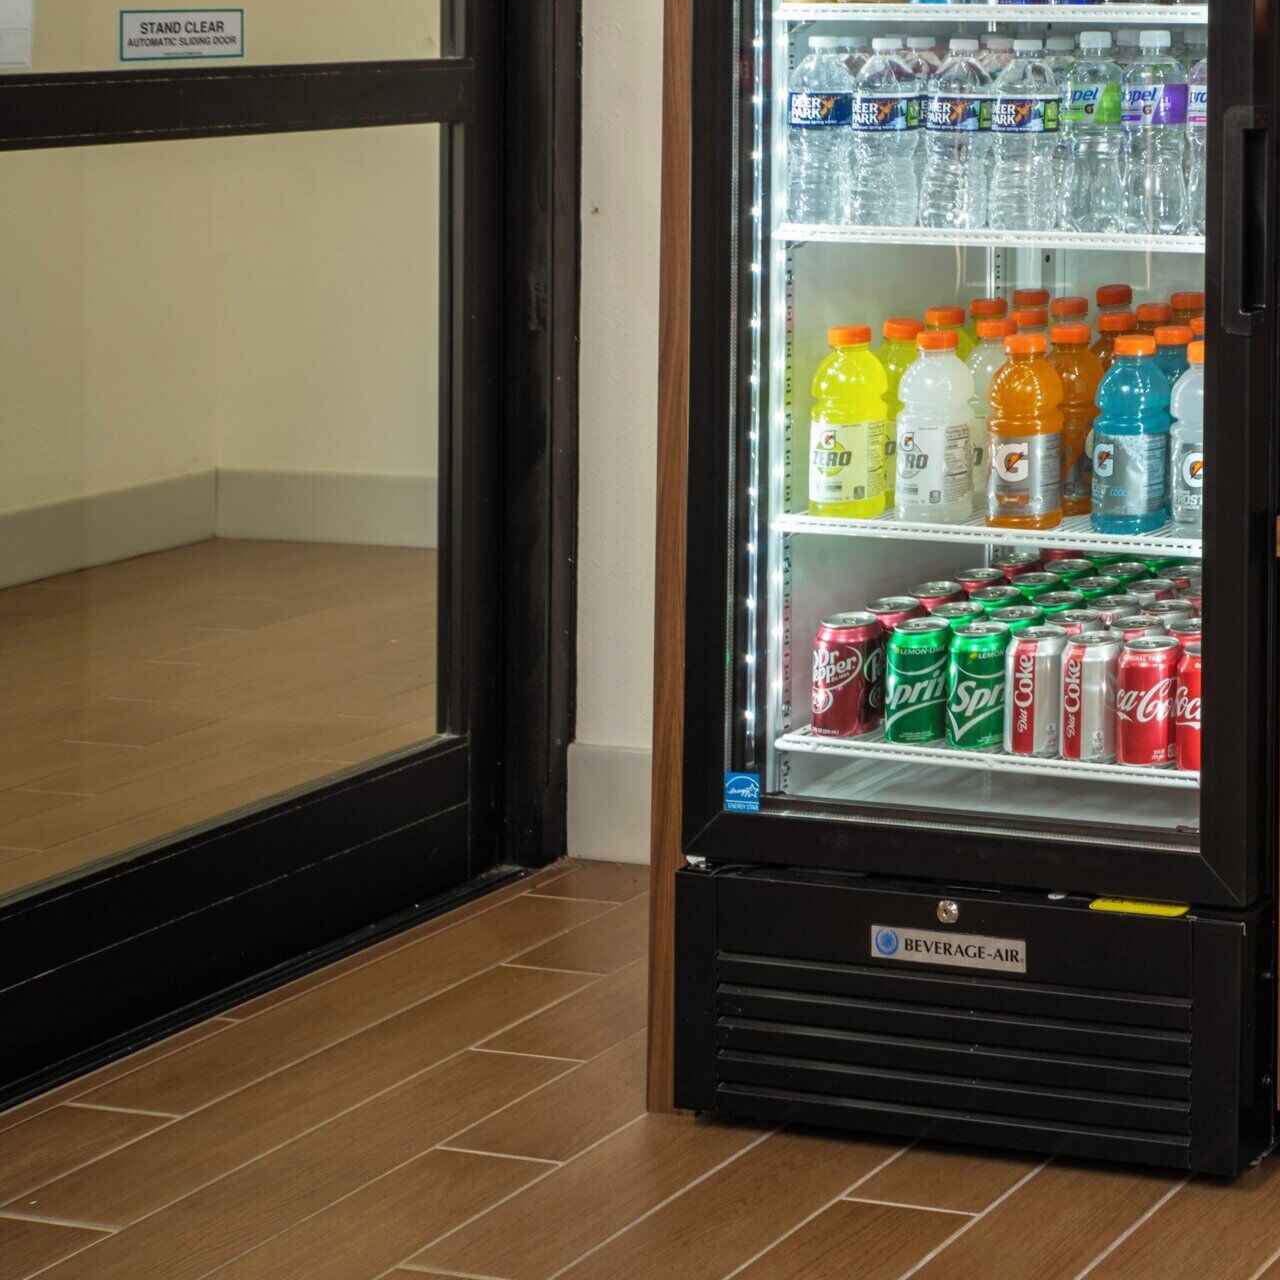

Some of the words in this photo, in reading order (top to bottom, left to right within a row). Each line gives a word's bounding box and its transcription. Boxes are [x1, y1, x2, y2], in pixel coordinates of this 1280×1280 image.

[140, 21, 181, 35] STAND
[184, 20, 225, 34] CLEAR
[128, 37, 176, 48] AUTOMATIC
[179, 36, 211, 46] SLIDING
[213, 35, 237, 45] DOOR
[792, 95, 821, 108] DEER
[792, 107, 822, 119] PARK
[927, 112, 951, 123] PARK
[813, 451, 852, 467] ZERO
[996, 442, 1029, 482] G
[818, 649, 839, 668] Dr
[1015, 653, 1034, 708] Coke
[904, 937, 1021, 964] BEVERAGE-AIR
